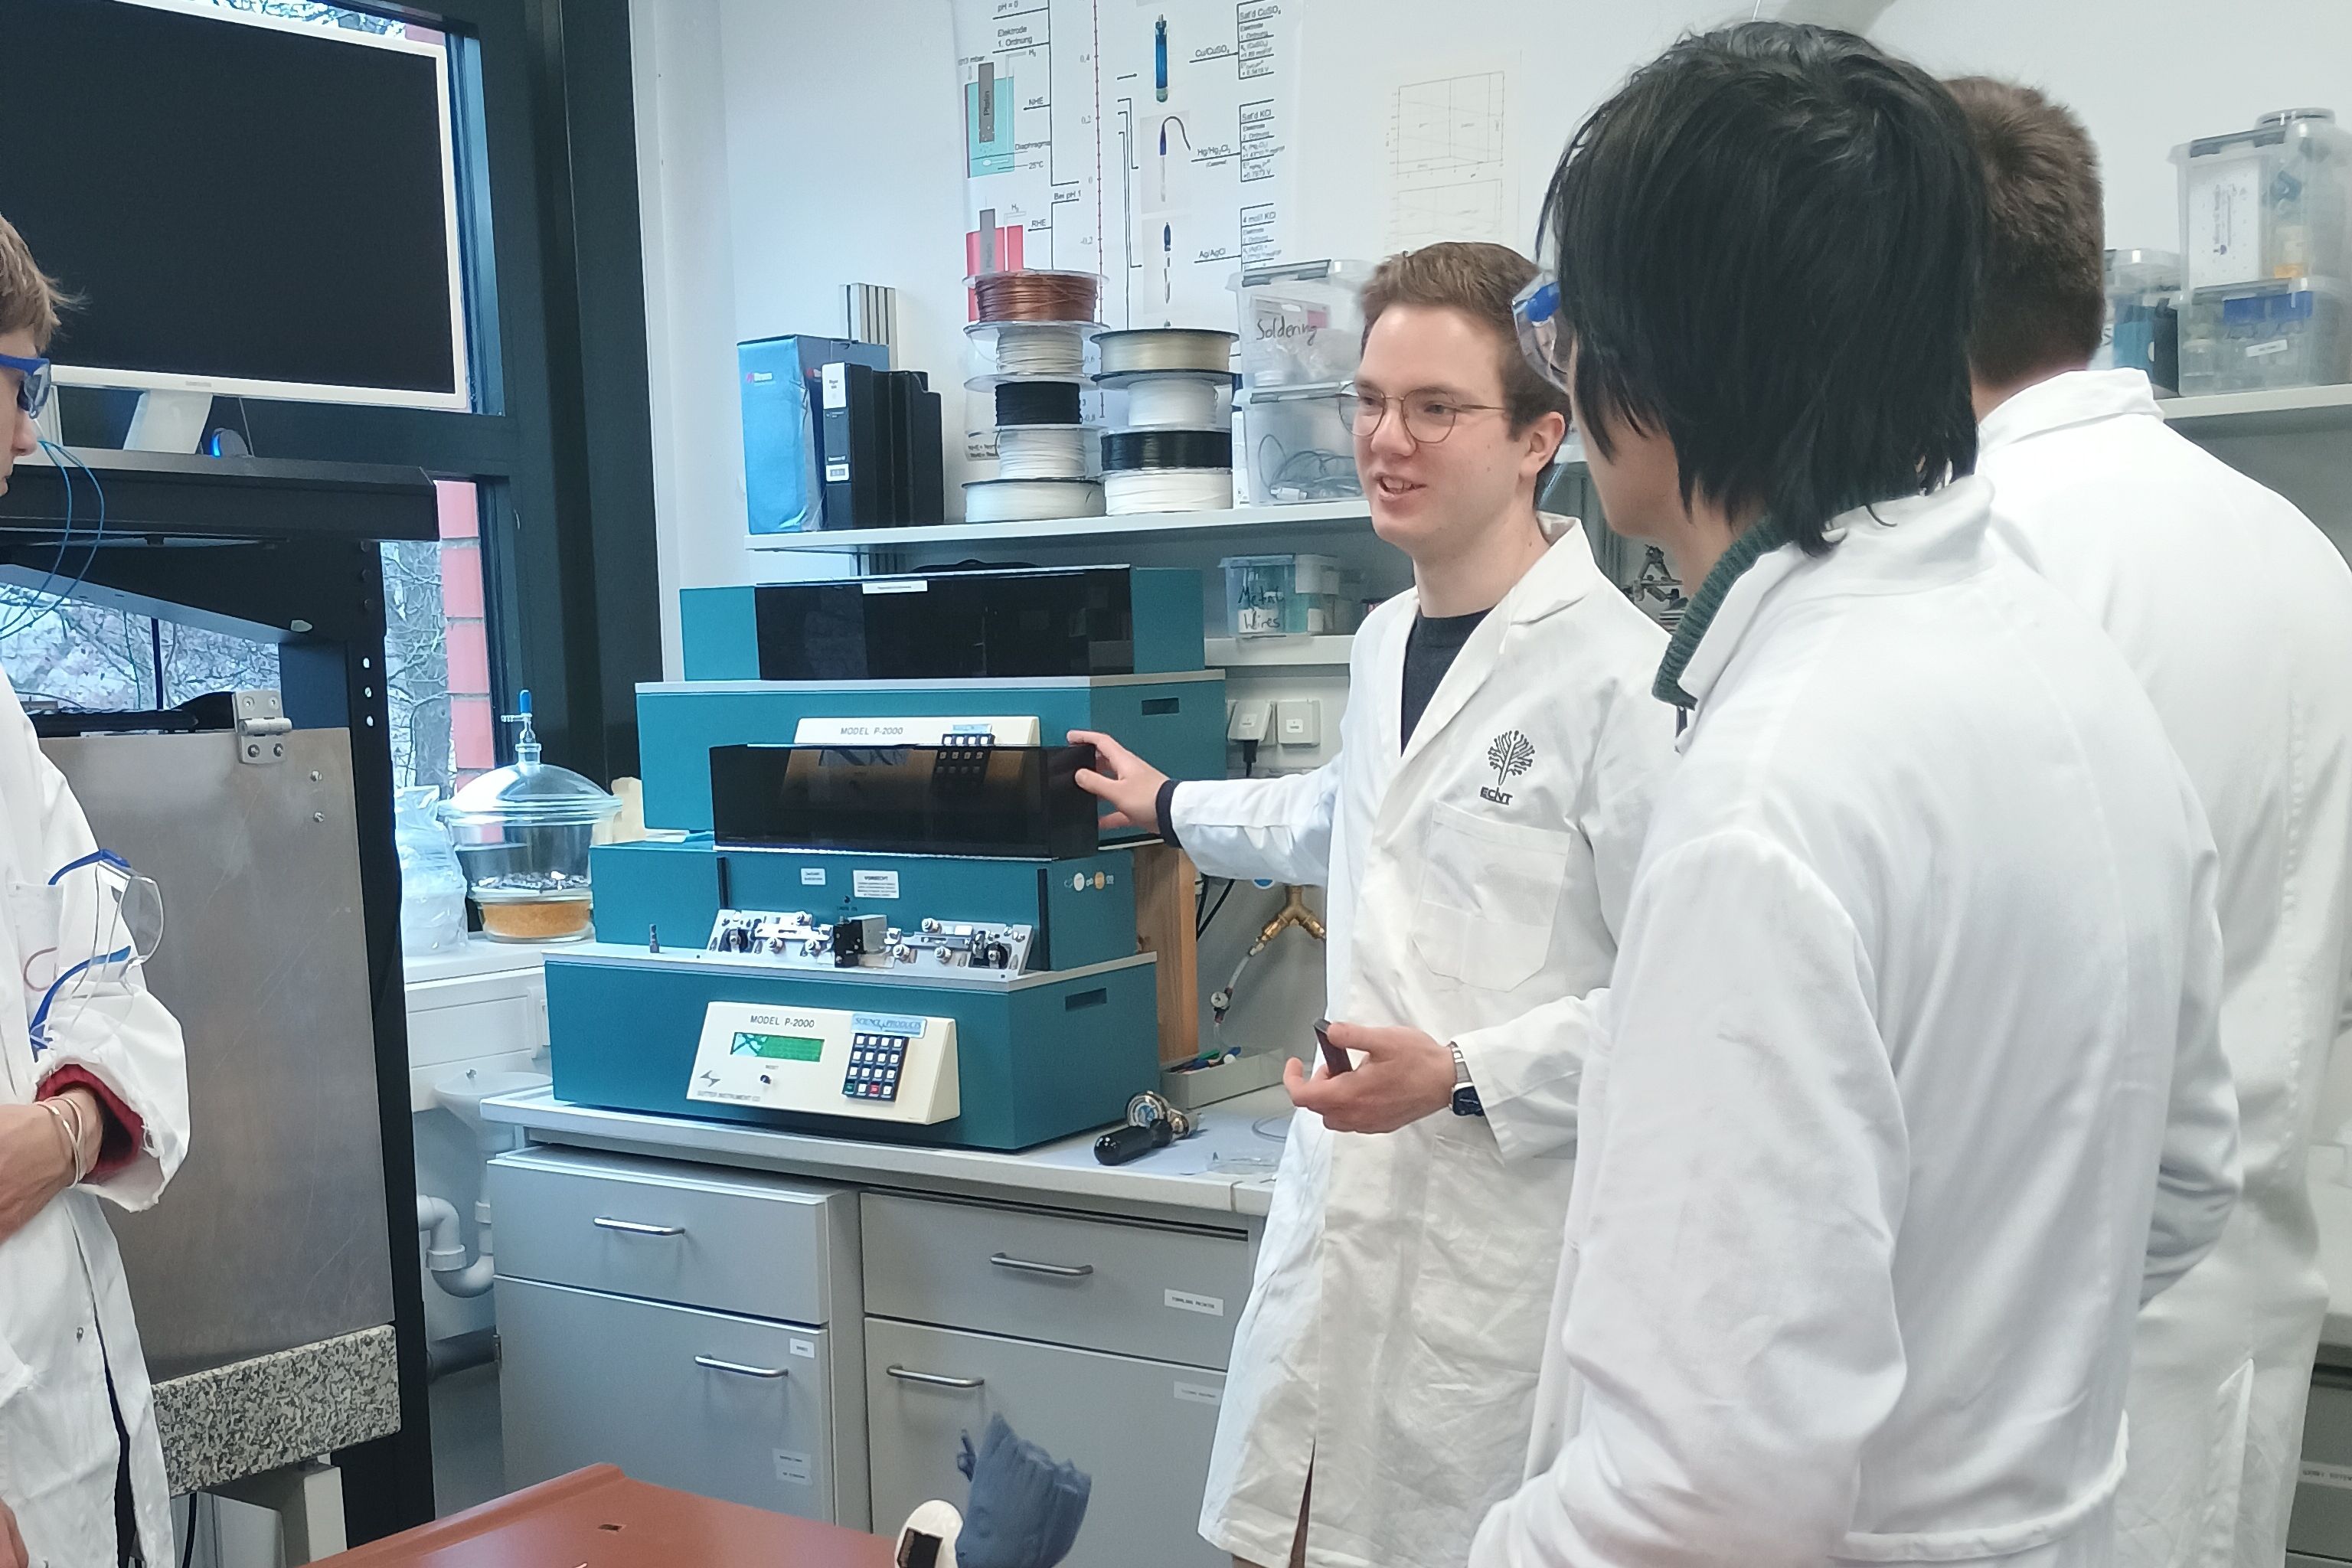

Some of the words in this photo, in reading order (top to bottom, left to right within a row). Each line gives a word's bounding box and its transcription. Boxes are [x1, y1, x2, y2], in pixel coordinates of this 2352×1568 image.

[1005, 37, 1032, 46] Ordnung
[1028, 96, 1044, 105] NHE
[1066, 191, 1077, 200] pH
[1031, 218, 1047, 227] RHE
[1256, 315, 1317, 346] Soldering
[1244, 611, 1280, 630] Wires
[874, 727, 903, 735] P-2000
[750, 1015, 780, 1025] MODEL
[785, 1018, 815, 1028] P-2000
